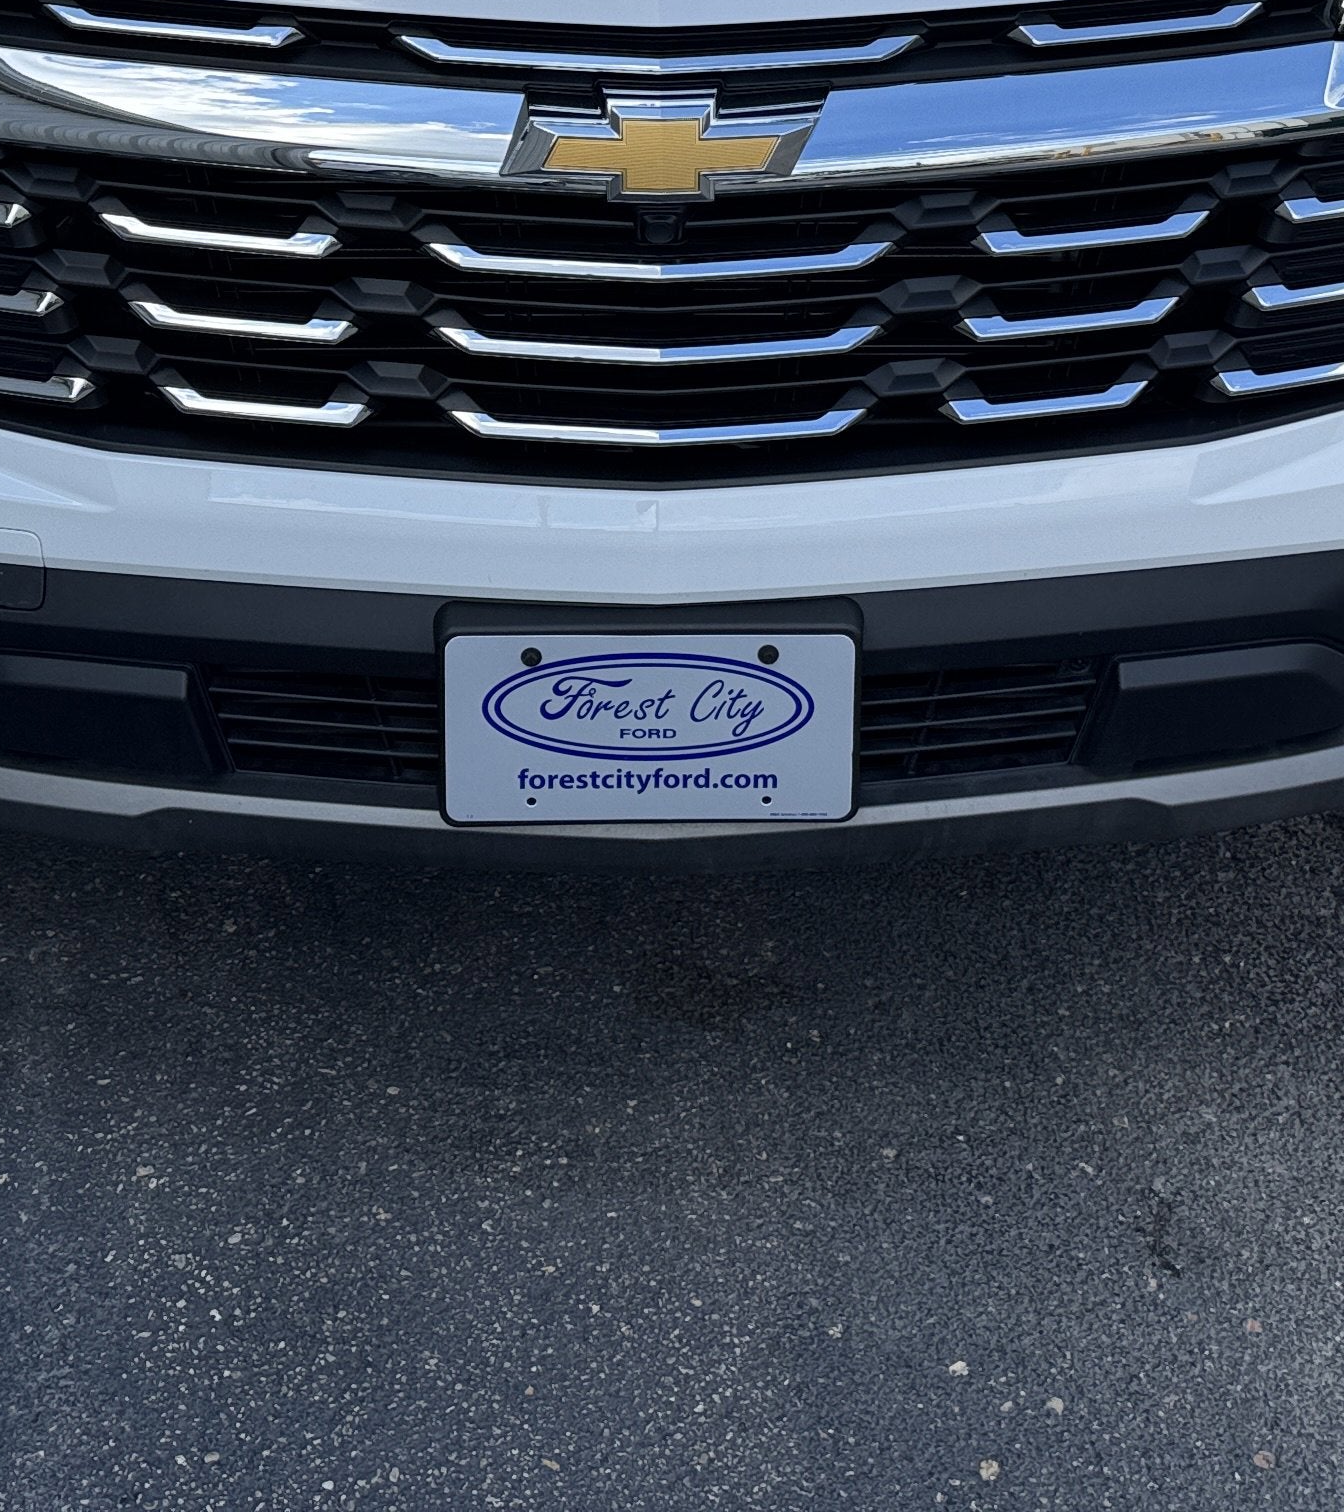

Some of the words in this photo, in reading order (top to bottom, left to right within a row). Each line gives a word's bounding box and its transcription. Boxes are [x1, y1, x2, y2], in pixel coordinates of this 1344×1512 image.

[539, 675, 676, 721] Forest
[689, 679, 765, 738] City
[619, 728, 677, 739] FORD
[517, 767, 778, 795] forestcityford.com
